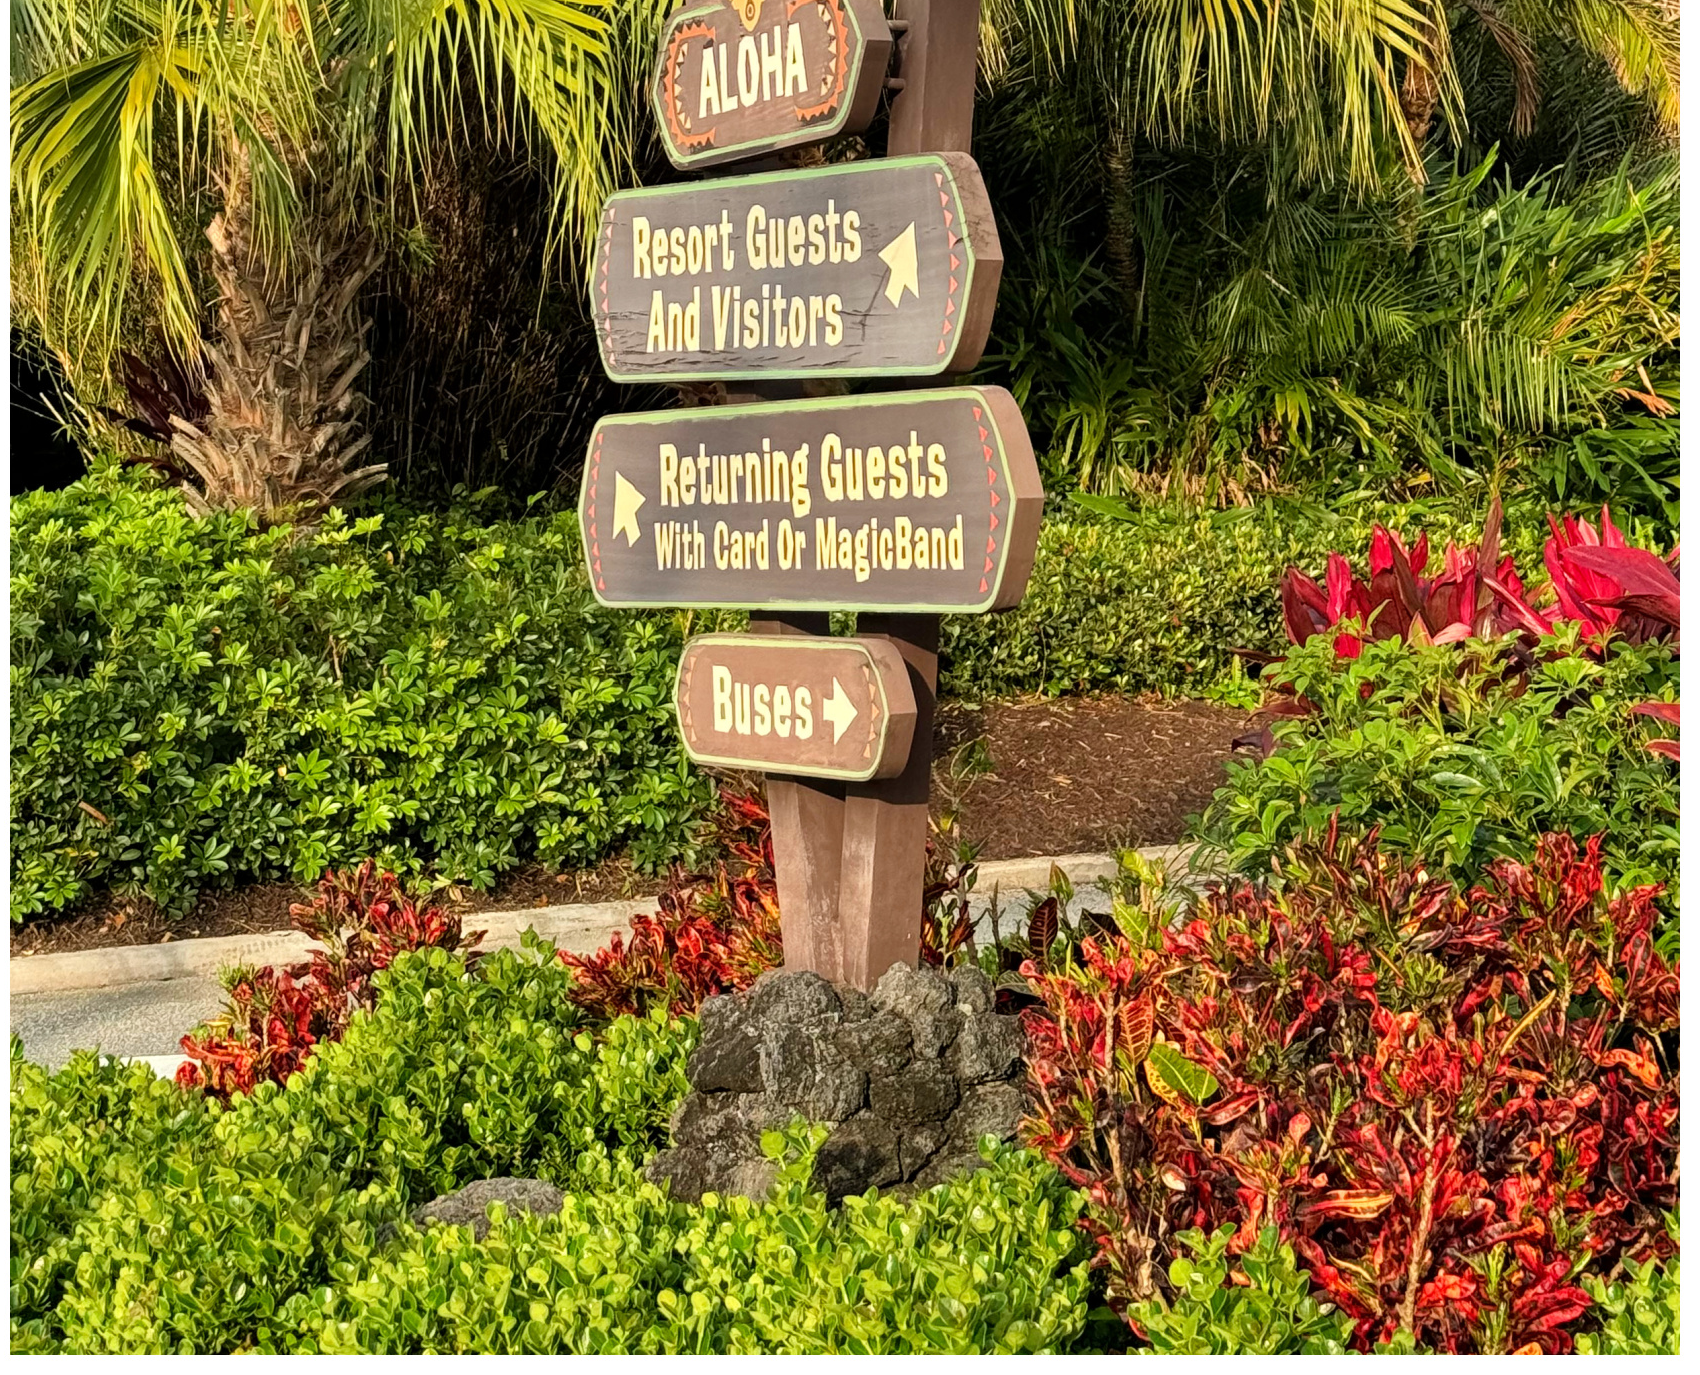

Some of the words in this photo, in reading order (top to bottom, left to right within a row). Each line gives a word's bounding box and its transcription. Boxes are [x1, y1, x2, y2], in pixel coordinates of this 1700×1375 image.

[697, 21, 808, 119] ALOHA
[632, 208, 735, 279] Resort
[746, 198, 863, 274] Guests
[646, 279, 701, 354] And
[710, 283, 844, 352] Visitors
[658, 437, 811, 518] Returning
[820, 430, 949, 502] Guests
[653, 520, 705, 571] With
[713, 518, 769, 571] Card
[776, 517, 807, 571] Or
[814, 514, 965, 582] MagicBand
[711, 664, 814, 739] Buses
